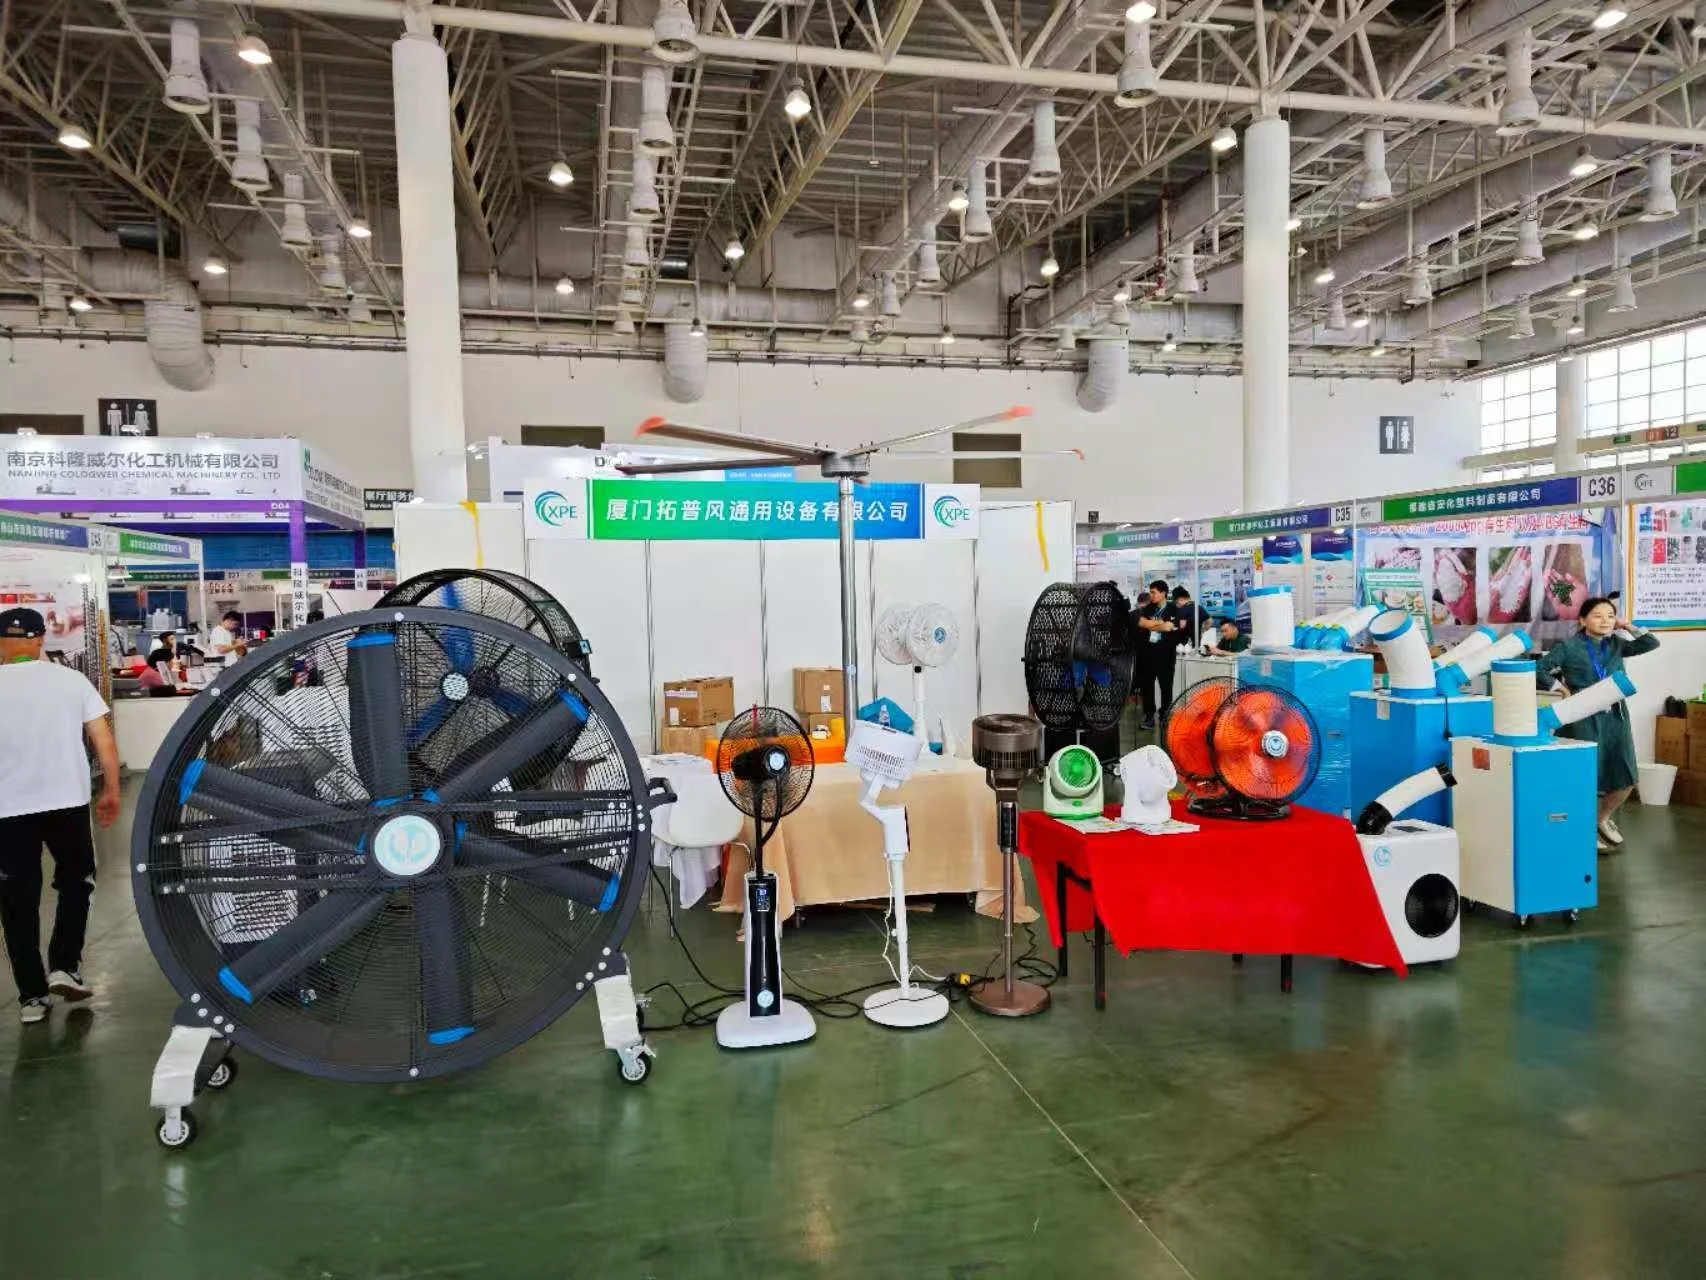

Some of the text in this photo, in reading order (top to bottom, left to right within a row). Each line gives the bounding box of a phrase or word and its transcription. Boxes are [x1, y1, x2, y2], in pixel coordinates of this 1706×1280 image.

[7, 451, 278, 469] 南京科隆威尔化工机械有限公司
[121, 470, 174, 479] CHEMICAL
[177, 471, 237, 479] MACHINERY
[1589, 477, 1616, 497] C36
[606, 499, 907, 522] 厦门拓普风通用设备有限公司
[1335, 508, 1351, 522] C35
